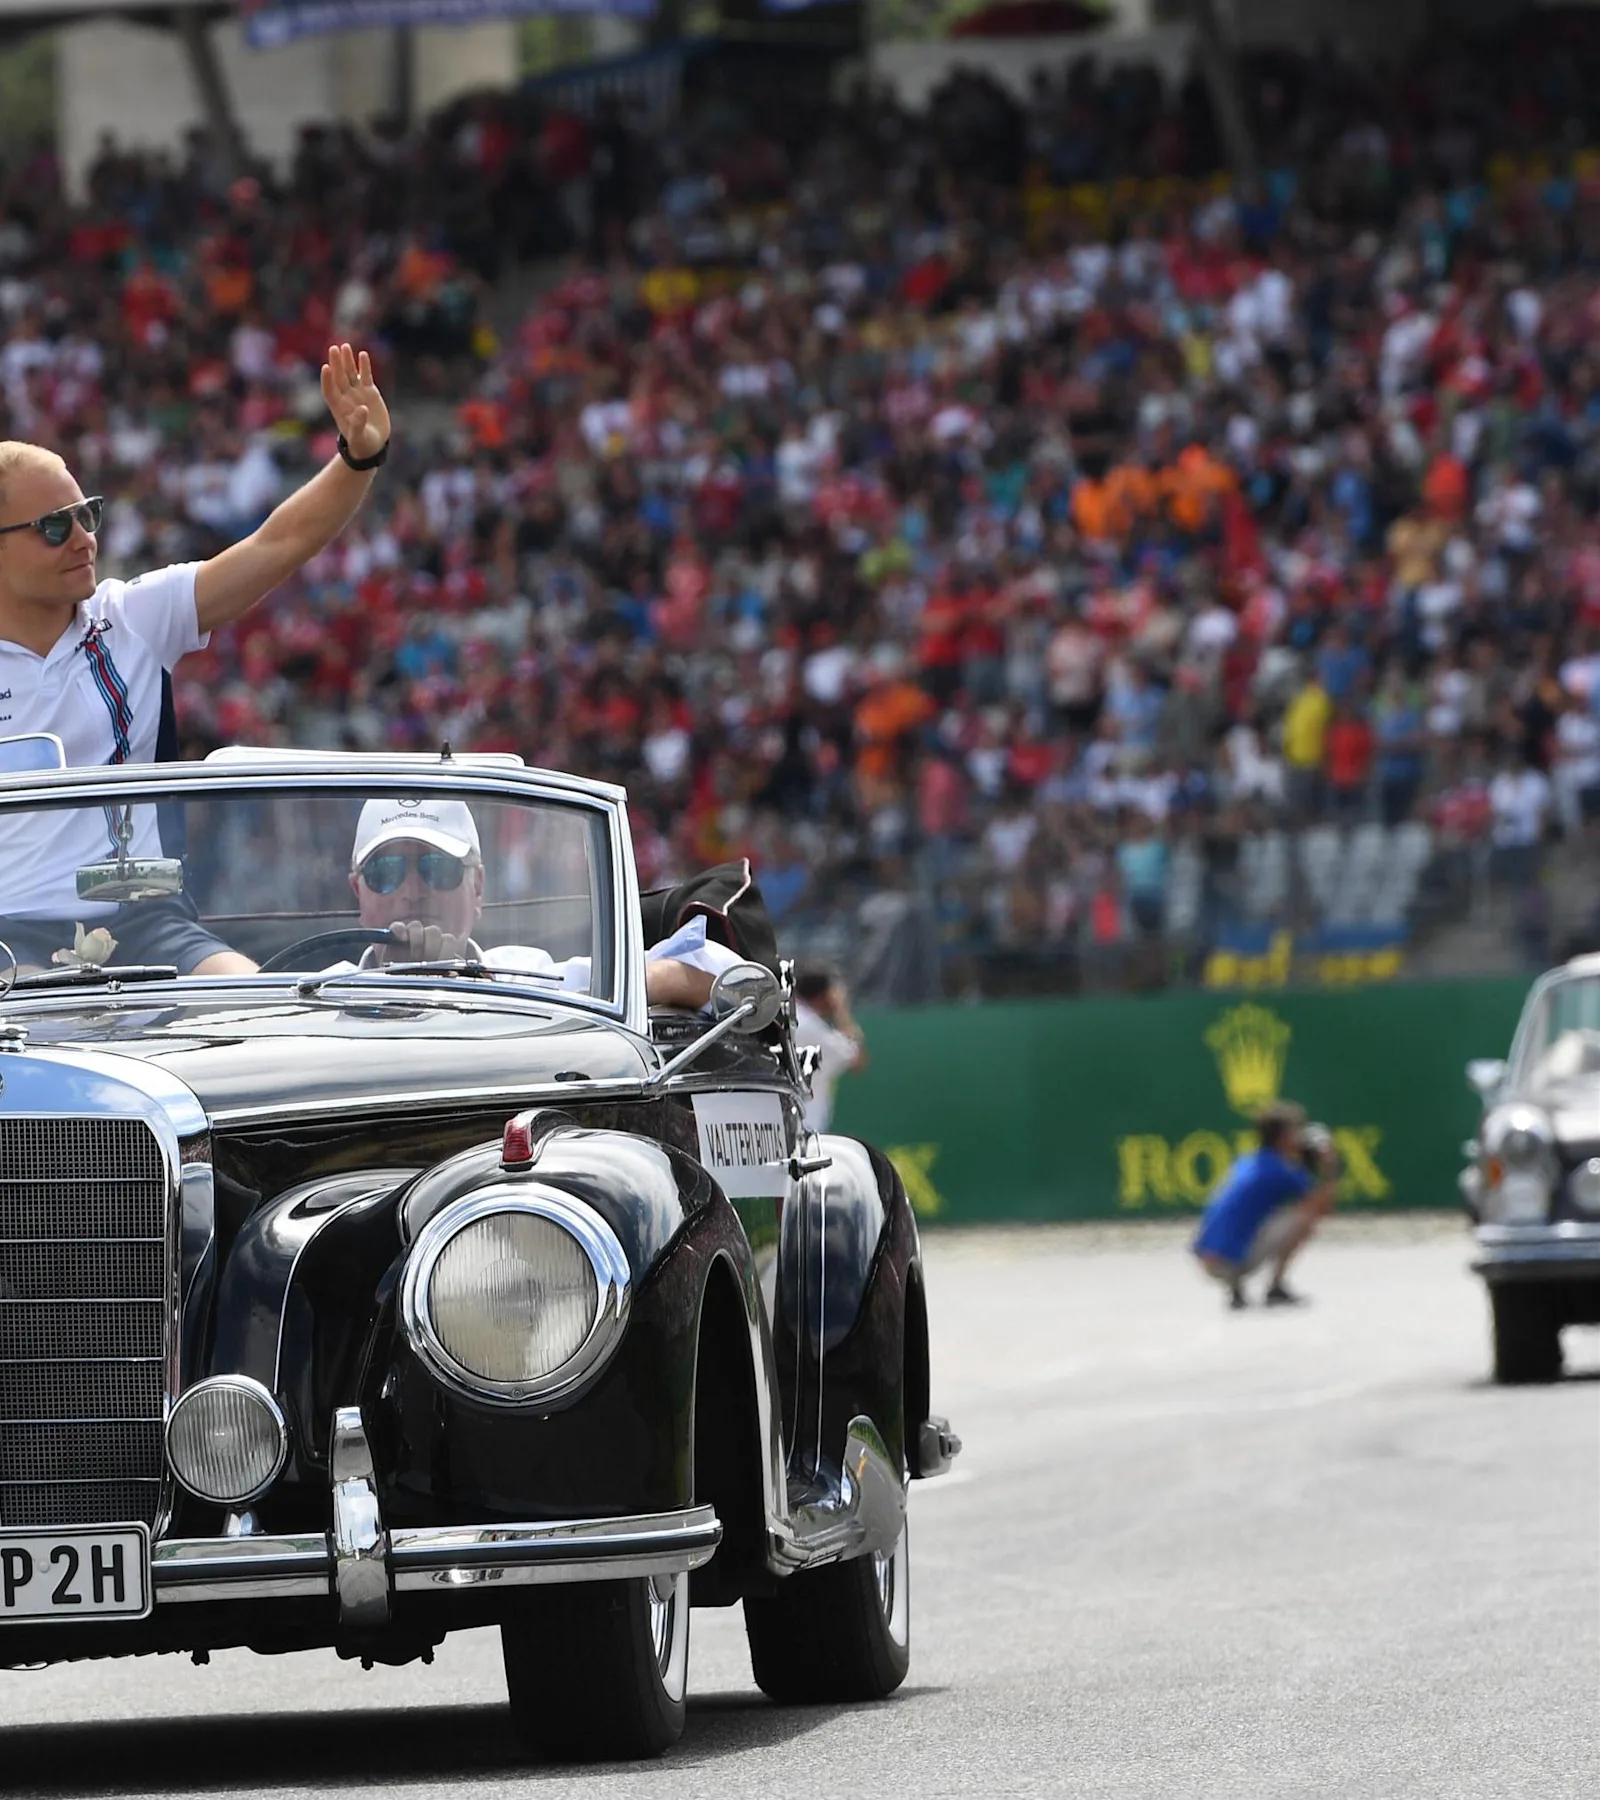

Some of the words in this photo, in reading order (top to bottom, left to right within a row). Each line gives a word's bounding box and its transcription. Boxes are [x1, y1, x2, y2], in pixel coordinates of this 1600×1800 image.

[705, 1122, 755, 1167] VALTTERI
[755, 1122, 784, 1166] BOTTAS
[0, 1548, 33, 1607] P
[50, 1544, 126, 1605] 2H
